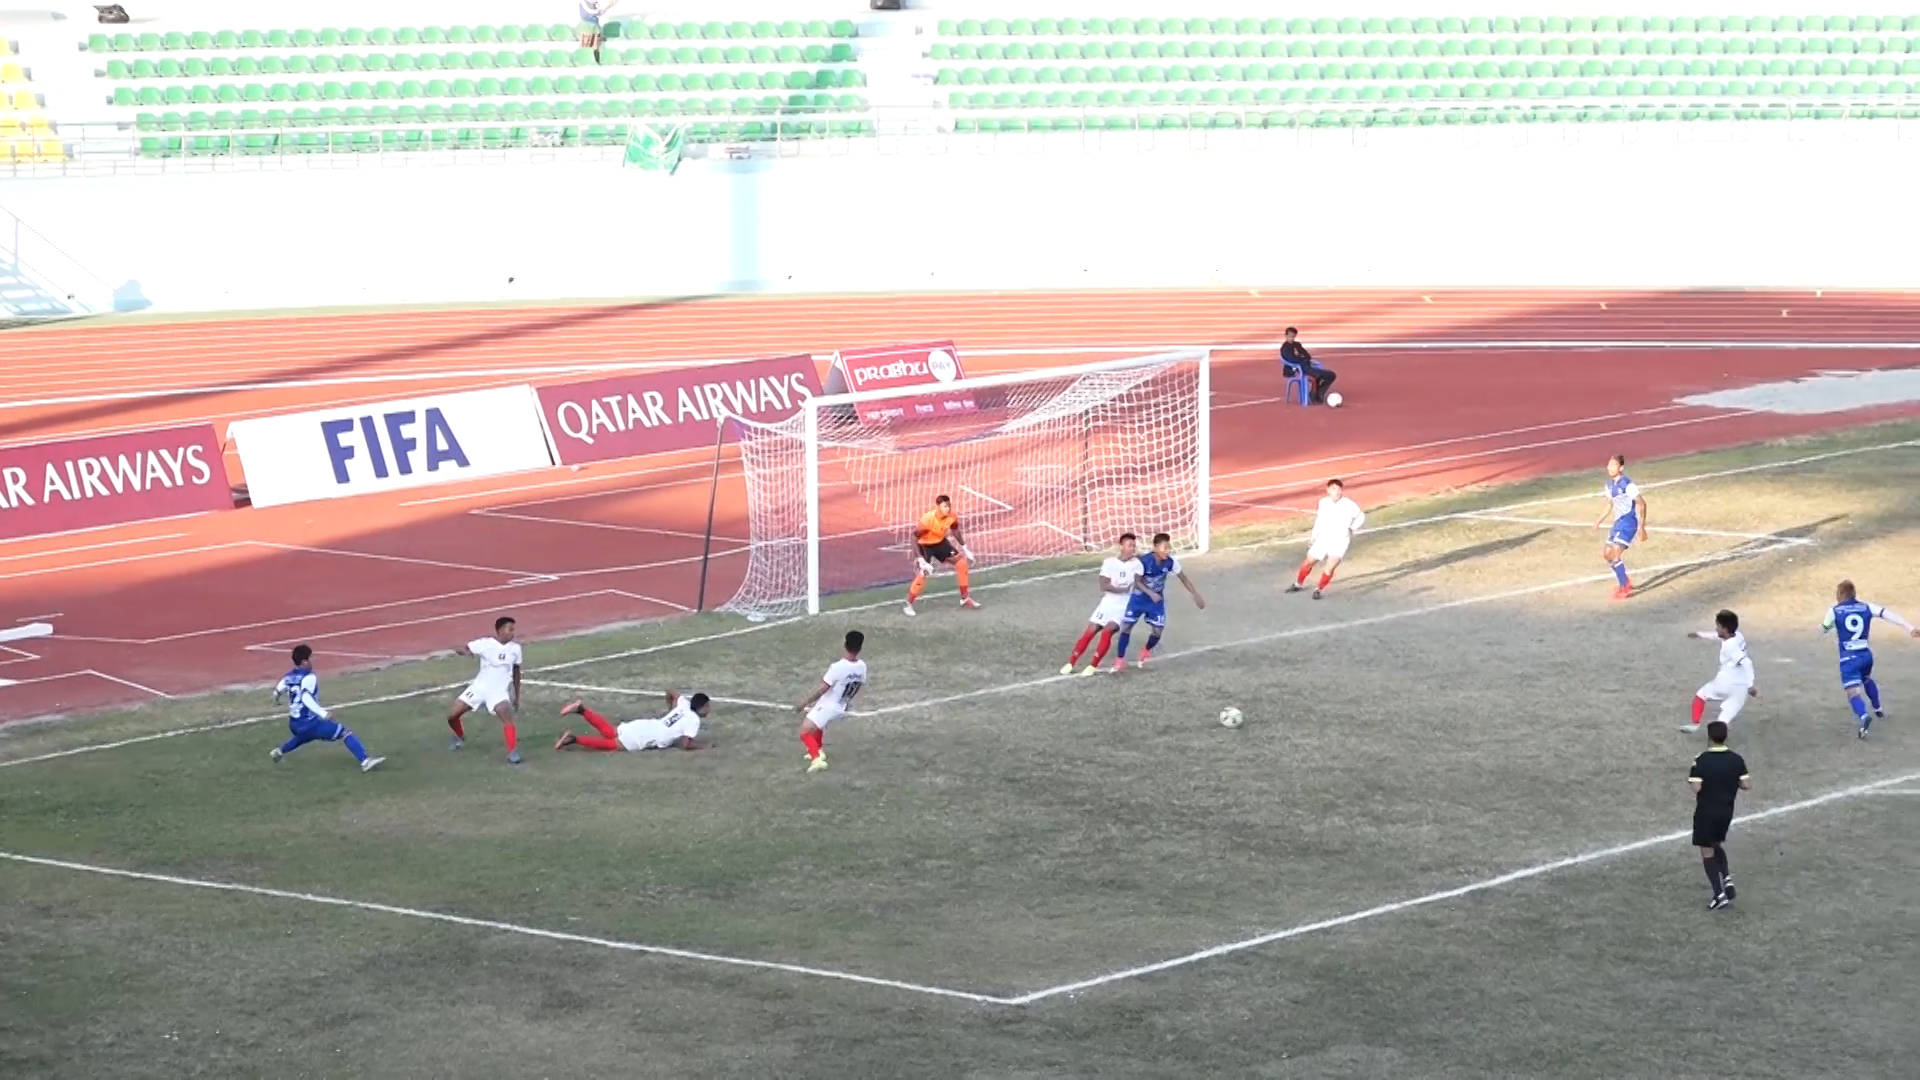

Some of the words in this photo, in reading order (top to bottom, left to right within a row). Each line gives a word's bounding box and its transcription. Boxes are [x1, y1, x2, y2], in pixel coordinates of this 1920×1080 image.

[557, 390, 673, 445] QATAR
[677, 372, 813, 423] AIRWAYS
[43, 445, 211, 503] AIRWAYS
[320, 407, 471, 484] FIFA
[1845, 613, 1864, 640] 9
